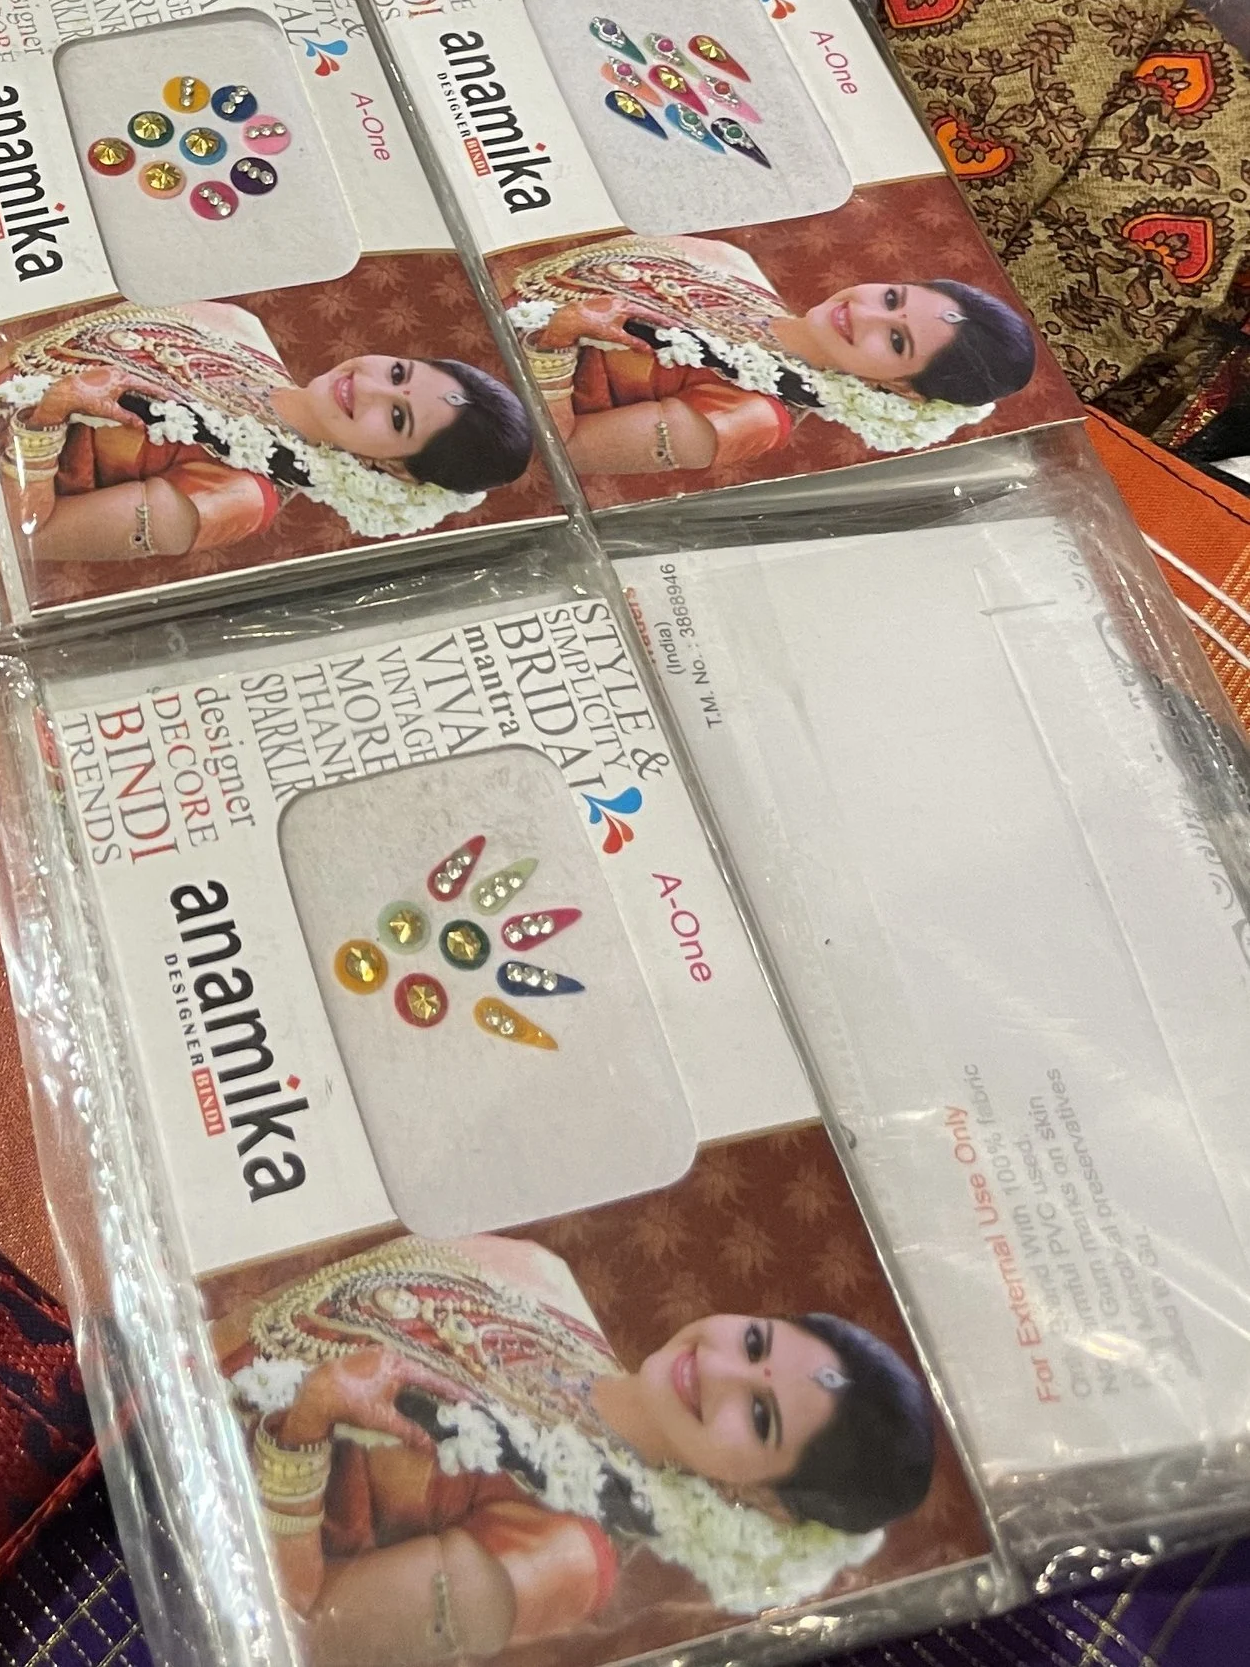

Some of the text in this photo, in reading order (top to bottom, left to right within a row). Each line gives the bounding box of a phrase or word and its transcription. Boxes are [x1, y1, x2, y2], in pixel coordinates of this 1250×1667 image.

[809, 31, 858, 94] A-One
[351, 92, 390, 161] A-One
[437, 72, 490, 175] DESIGNER BINDI
[440, 30, 552, 214] anamika
[654, 621, 686, 675] (India)
[660, 563, 695, 638] 3868946
[328, 654, 401, 775] MORE
[377, 645, 439, 763] VINTAGE
[416, 632, 491, 755] VIVA
[462, 624, 520, 738] mantra
[544, 608, 632, 772] SIMPLICITY
[572, 603, 670, 781] STYLE &
[691, 654, 710, 685] No.
[700, 689, 722, 729] T.M.
[61, 713, 122, 865] TRENDS
[94, 701, 180, 865] BINDI
[152, 692, 220, 847] DECORE
[194, 686, 256, 827] designer
[651, 873, 712, 982] A-One
[164, 953, 224, 1134] DESIGNER BINDI
[170, 879, 310, 1203] anamika
[963, 1062, 996, 1126] fabric
[1028, 1094, 1056, 1142] skin
[1046, 1068, 1113, 1218] preservatives
[1049, 1146, 1068, 1176] on
[945, 1105, 1061, 1405] For External Use Only
[1036, 1201, 1069, 1258] PVC
